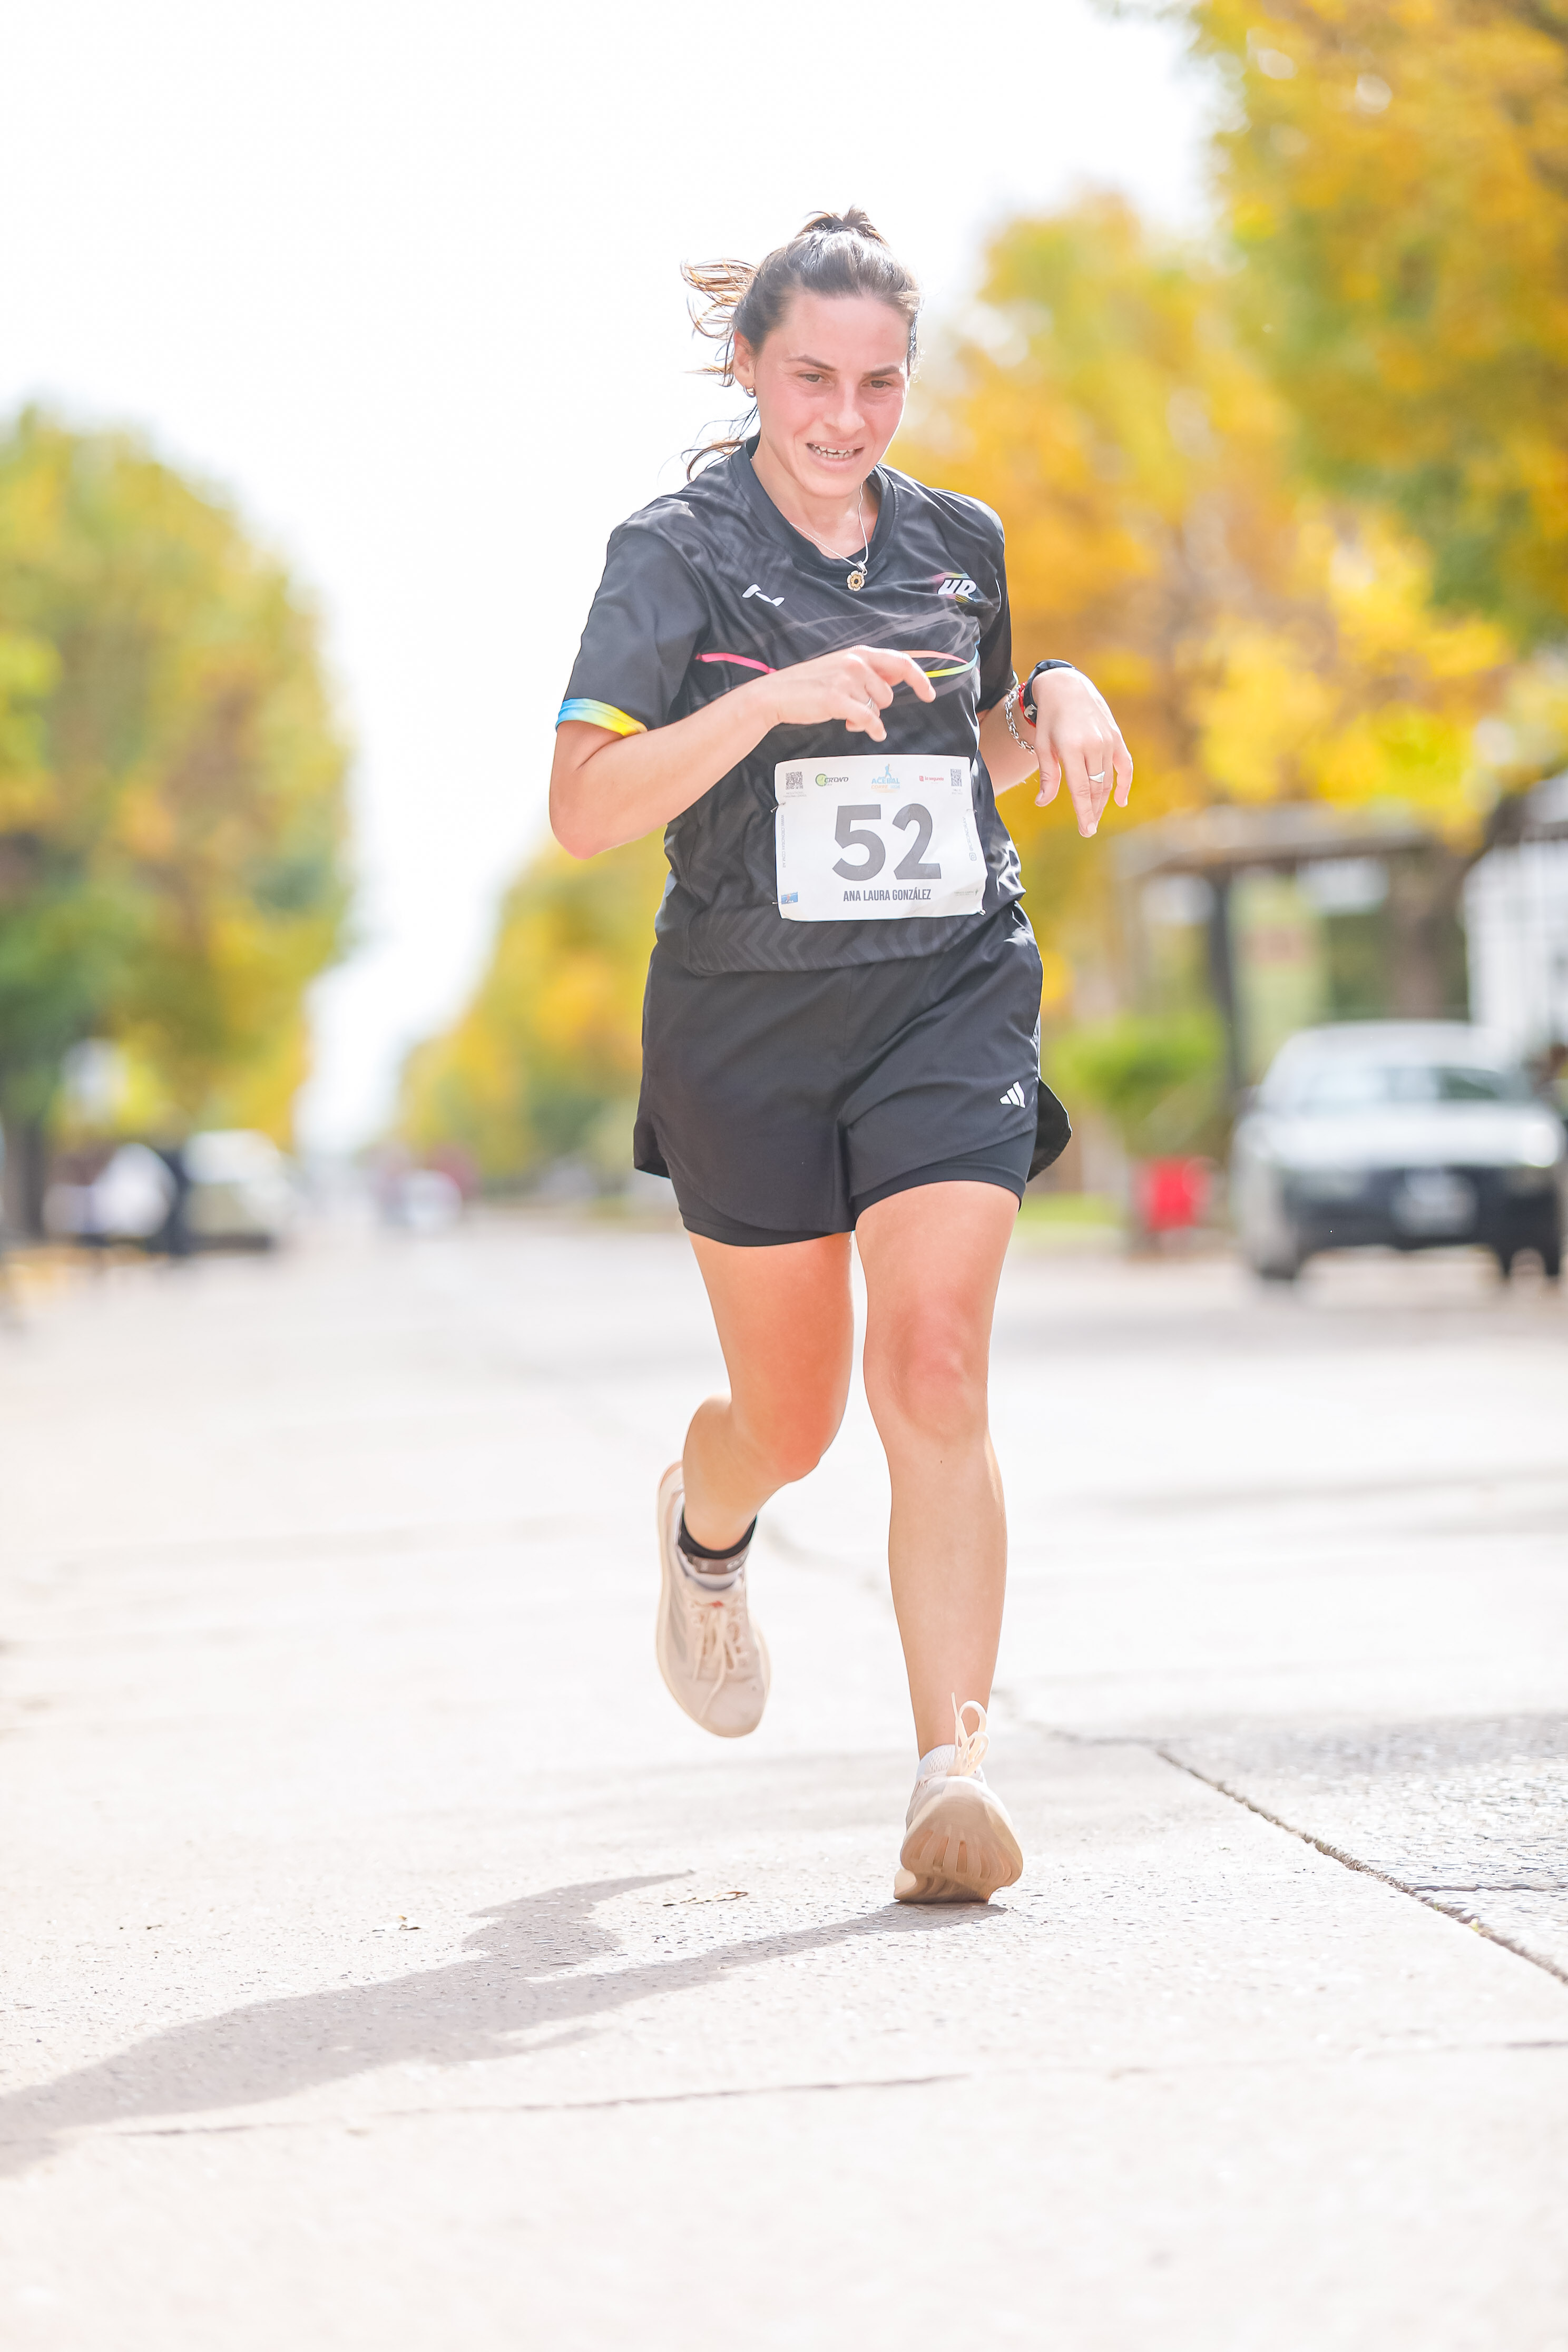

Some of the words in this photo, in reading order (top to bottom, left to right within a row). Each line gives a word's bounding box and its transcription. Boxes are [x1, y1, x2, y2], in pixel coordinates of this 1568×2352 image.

[832, 803, 942, 881] 52
[843, 890, 861, 901] ANA
[864, 890, 890, 901] LAURA
[892, 887, 932, 900] GONZÁLEZ
